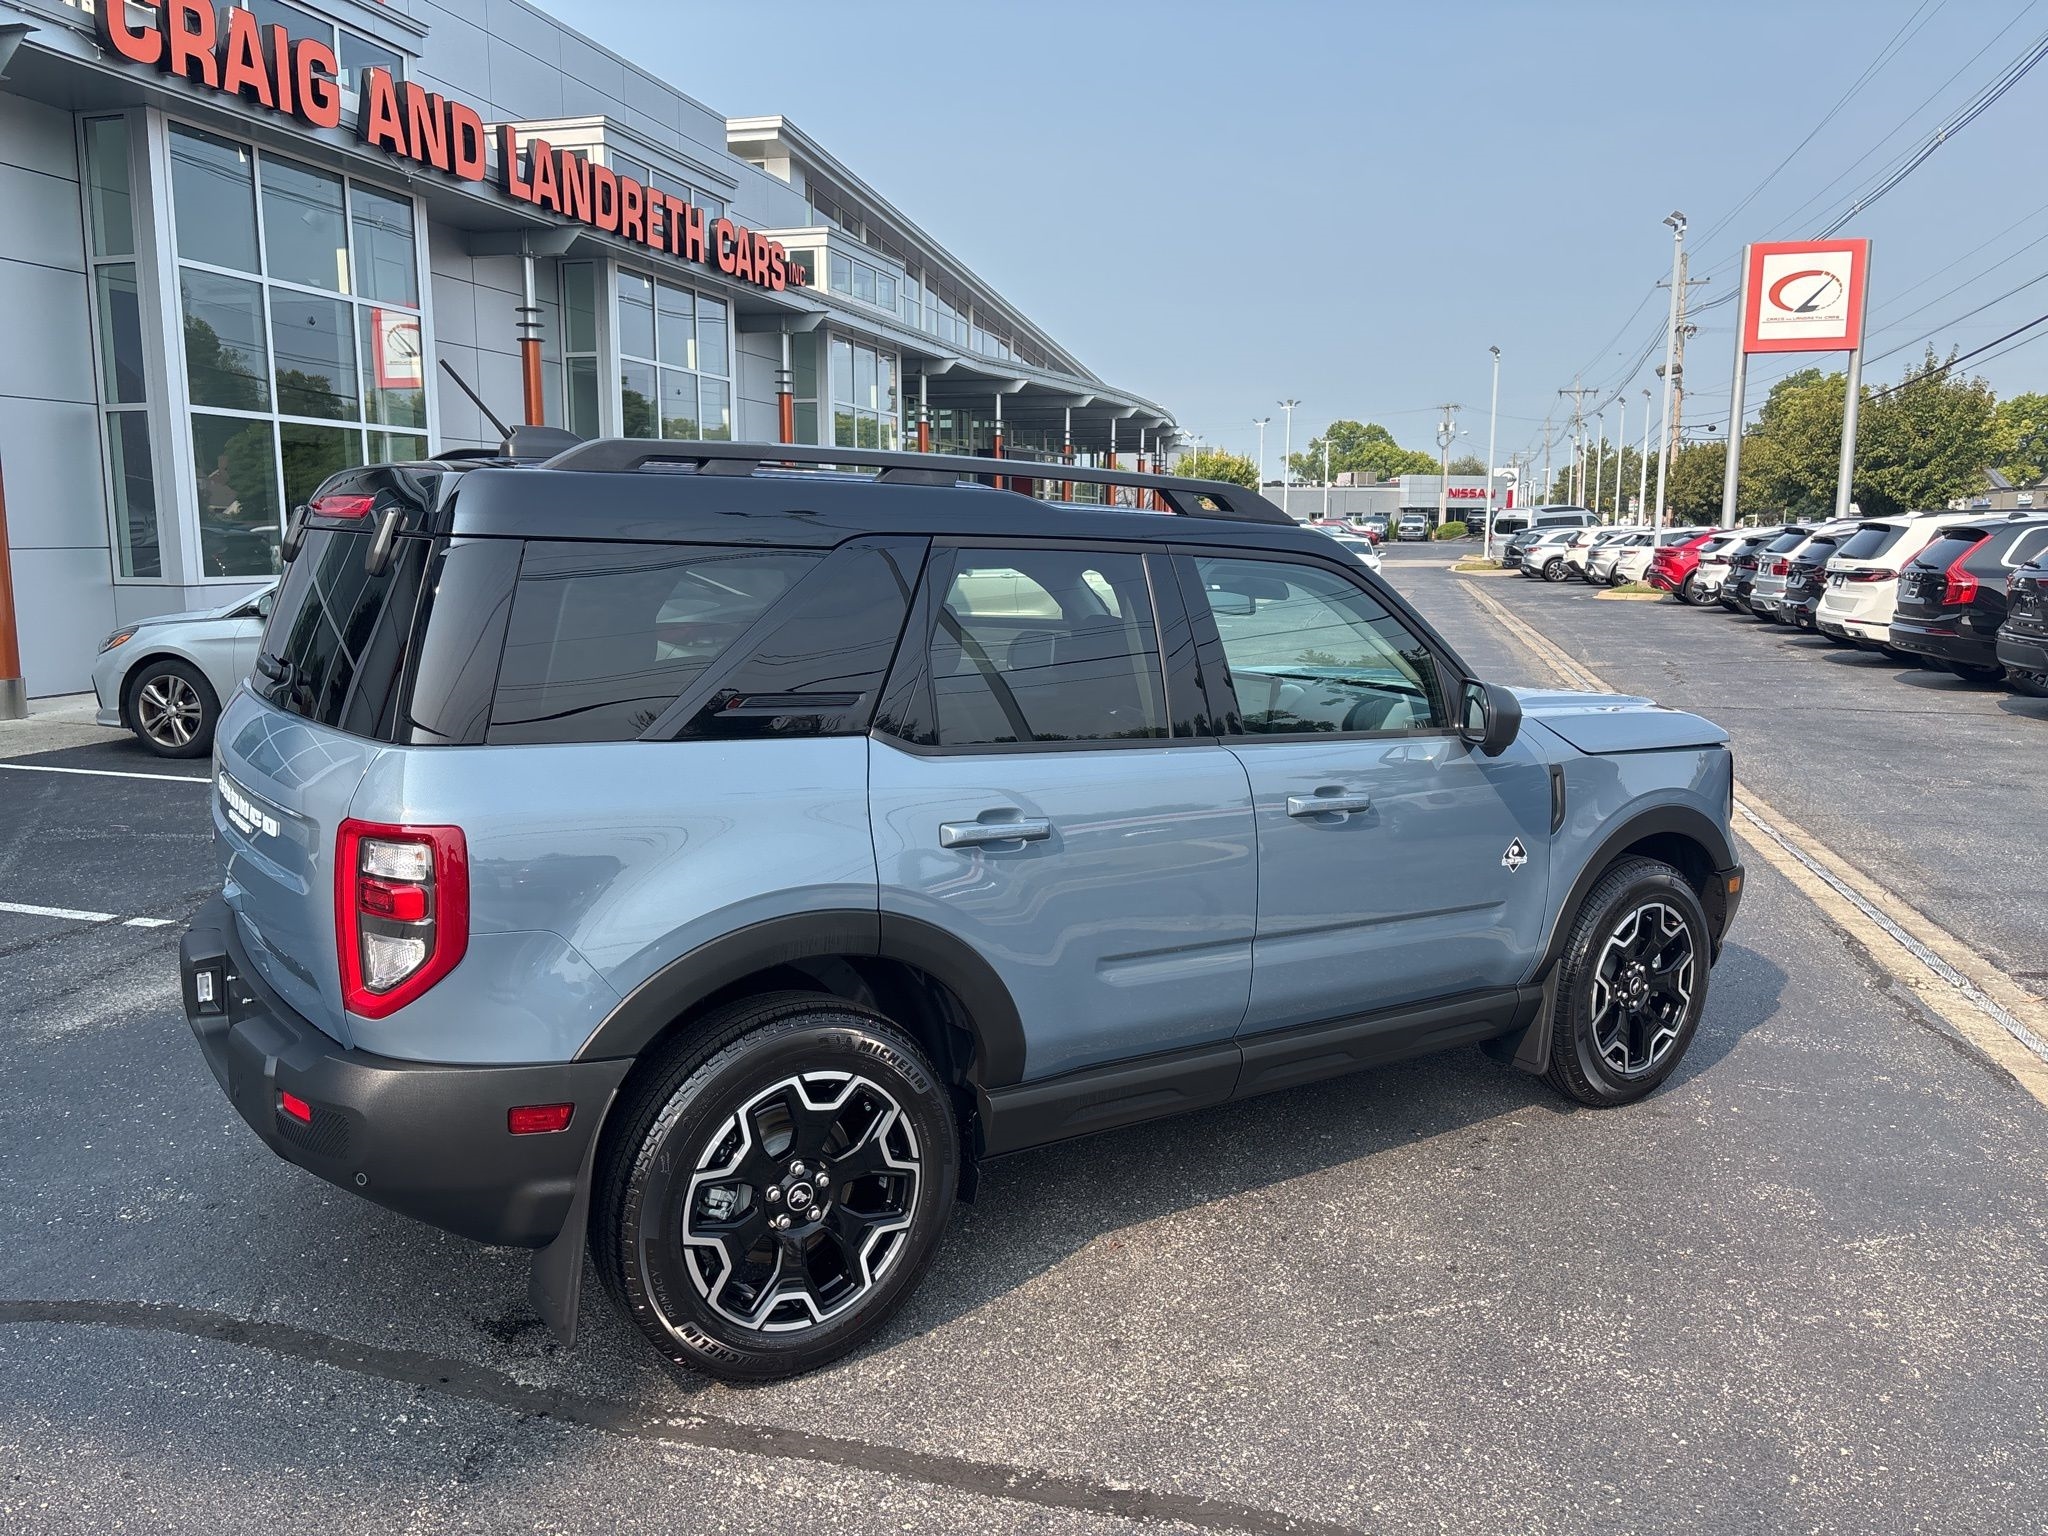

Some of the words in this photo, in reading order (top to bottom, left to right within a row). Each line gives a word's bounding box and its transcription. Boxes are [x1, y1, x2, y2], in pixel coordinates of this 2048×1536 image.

[105, 0, 340, 129] CRAIG
[366, 66, 487, 182] AND
[504, 124, 705, 264] LANDRETH
[716, 218, 786, 292] CARS
[788, 261, 806, 287] INC
[1448, 488, 1496, 498] NISSAN
[859, 1039, 928, 1091] MICHELIN
[652, 1270, 678, 1318] PRIMACY
